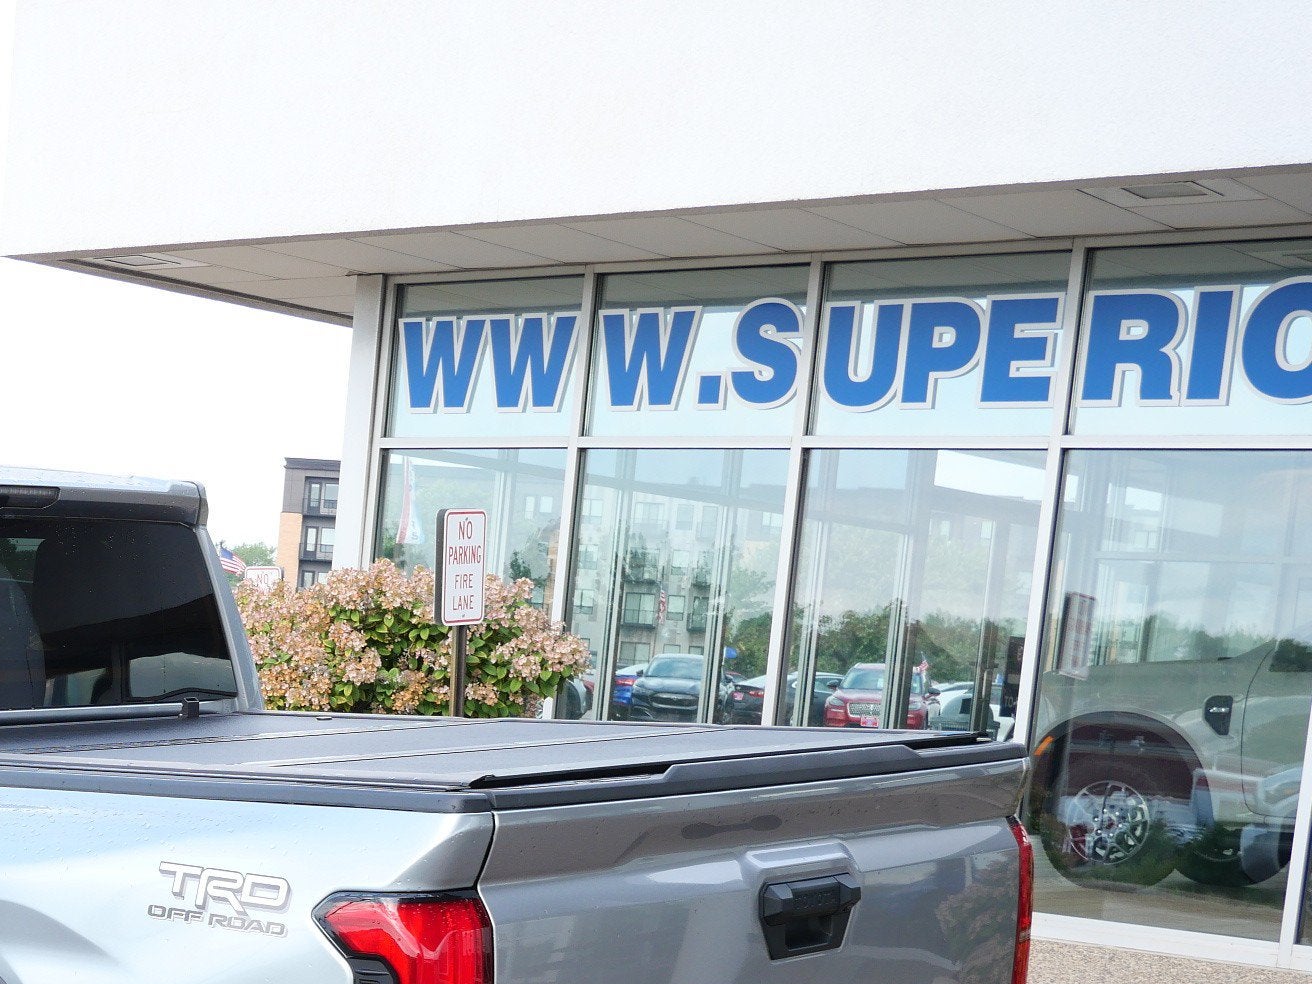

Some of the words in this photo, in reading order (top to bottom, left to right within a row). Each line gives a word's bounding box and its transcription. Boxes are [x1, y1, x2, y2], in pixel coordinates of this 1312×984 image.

[399, 275, 1312, 413] WWW.SUPERIO
[458, 520, 473, 540] NO
[448, 545, 482, 565] PARKING
[454, 573, 474, 589] FIRE
[452, 595, 474, 610] LANE
[158, 860, 292, 916] TRD
[147, 904, 204, 924] OFF
[208, 912, 289, 938] ROAD
